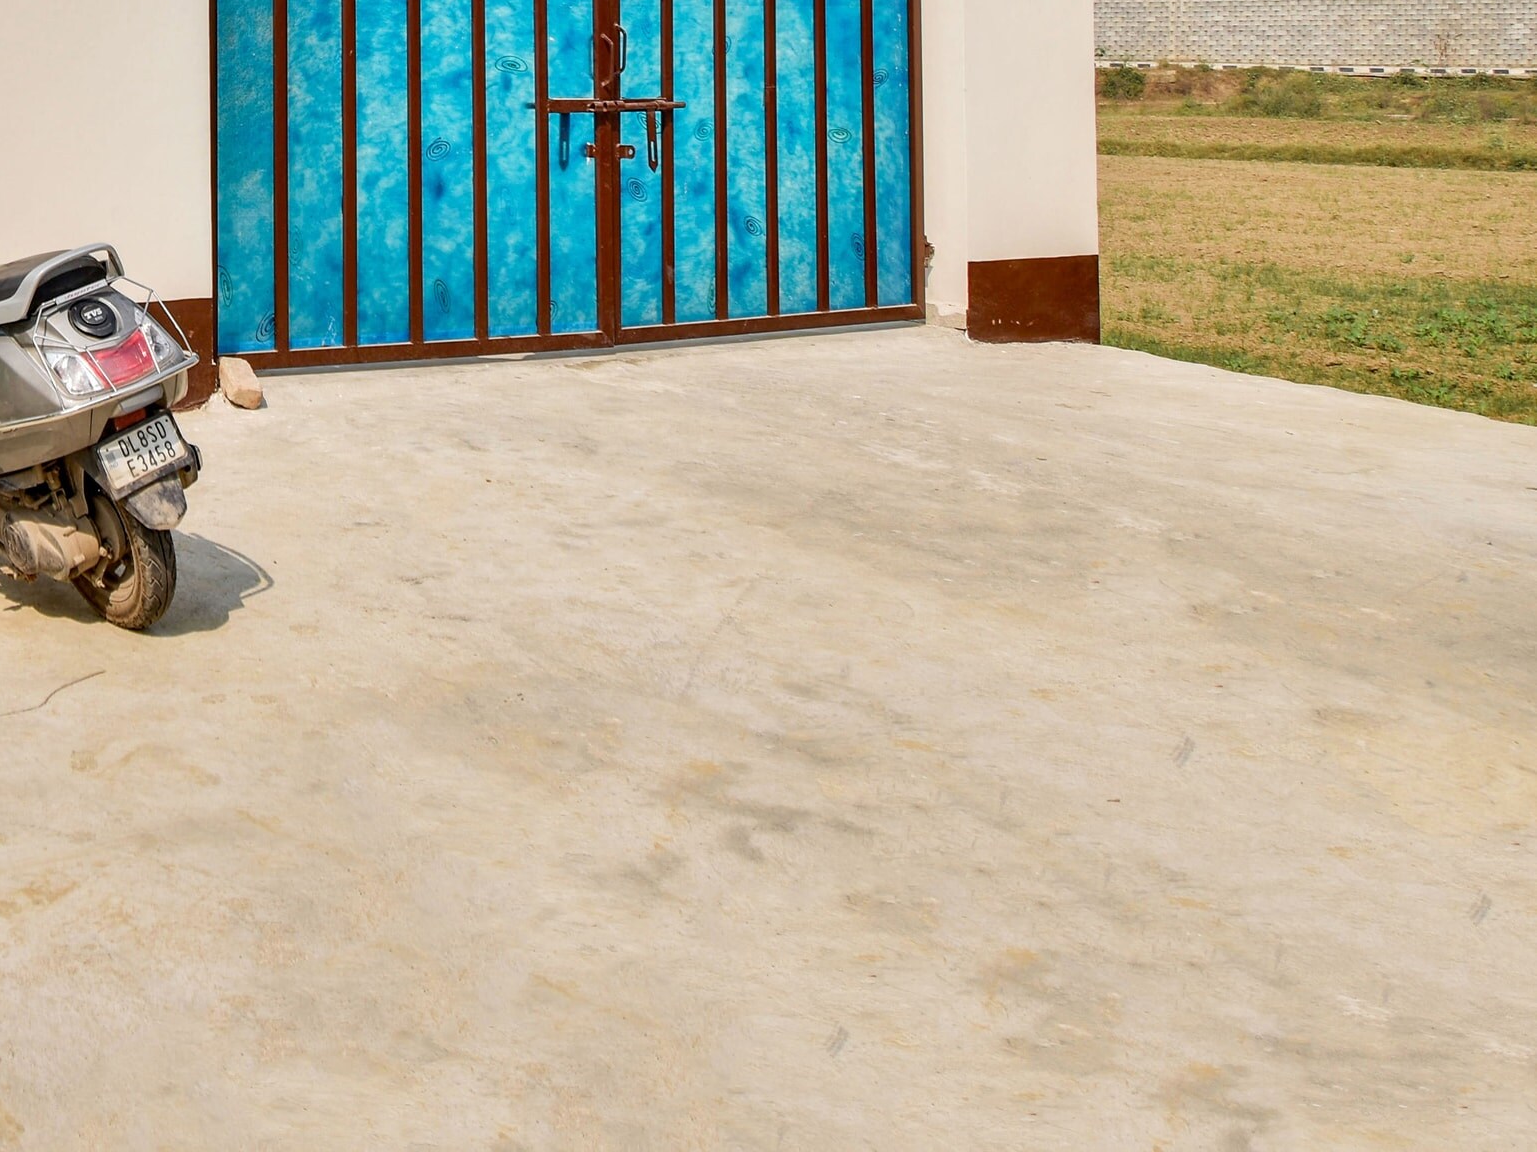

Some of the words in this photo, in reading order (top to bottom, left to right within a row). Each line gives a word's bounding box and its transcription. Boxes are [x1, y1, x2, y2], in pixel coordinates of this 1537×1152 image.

[83, 308, 103, 320] TVS
[117, 421, 168, 457] DL8SD
[126, 440, 176, 478] E3458
